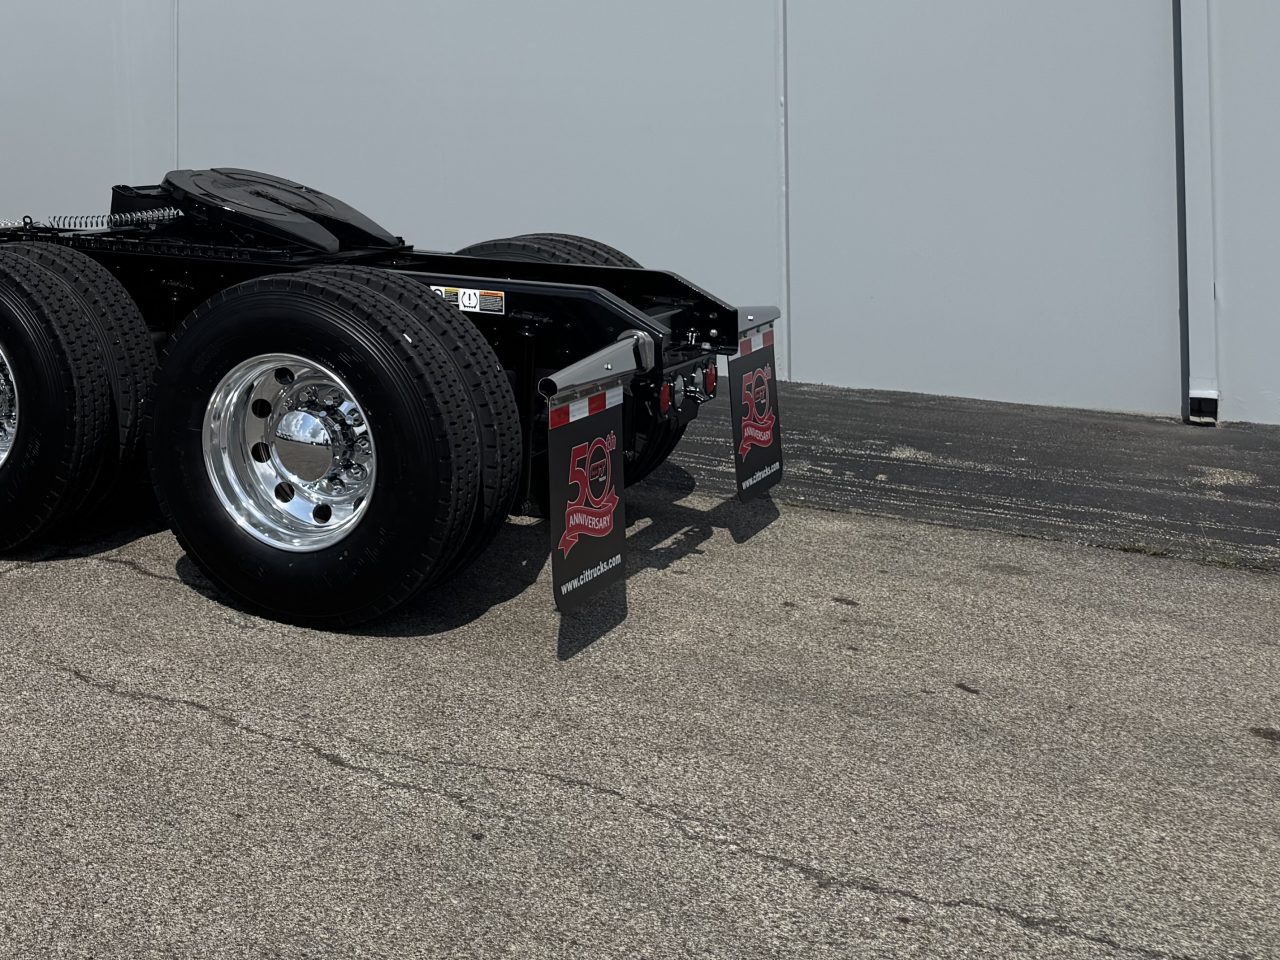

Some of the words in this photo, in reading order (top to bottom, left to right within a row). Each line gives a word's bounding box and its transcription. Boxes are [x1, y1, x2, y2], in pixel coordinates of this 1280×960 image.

[744, 426, 772, 441] ANNIVERSARY
[741, 461, 780, 491] www.cittrucks.com
[568, 512, 611, 530] ANNIVERSARY
[560, 553, 622, 596] www.cittrucks.com
